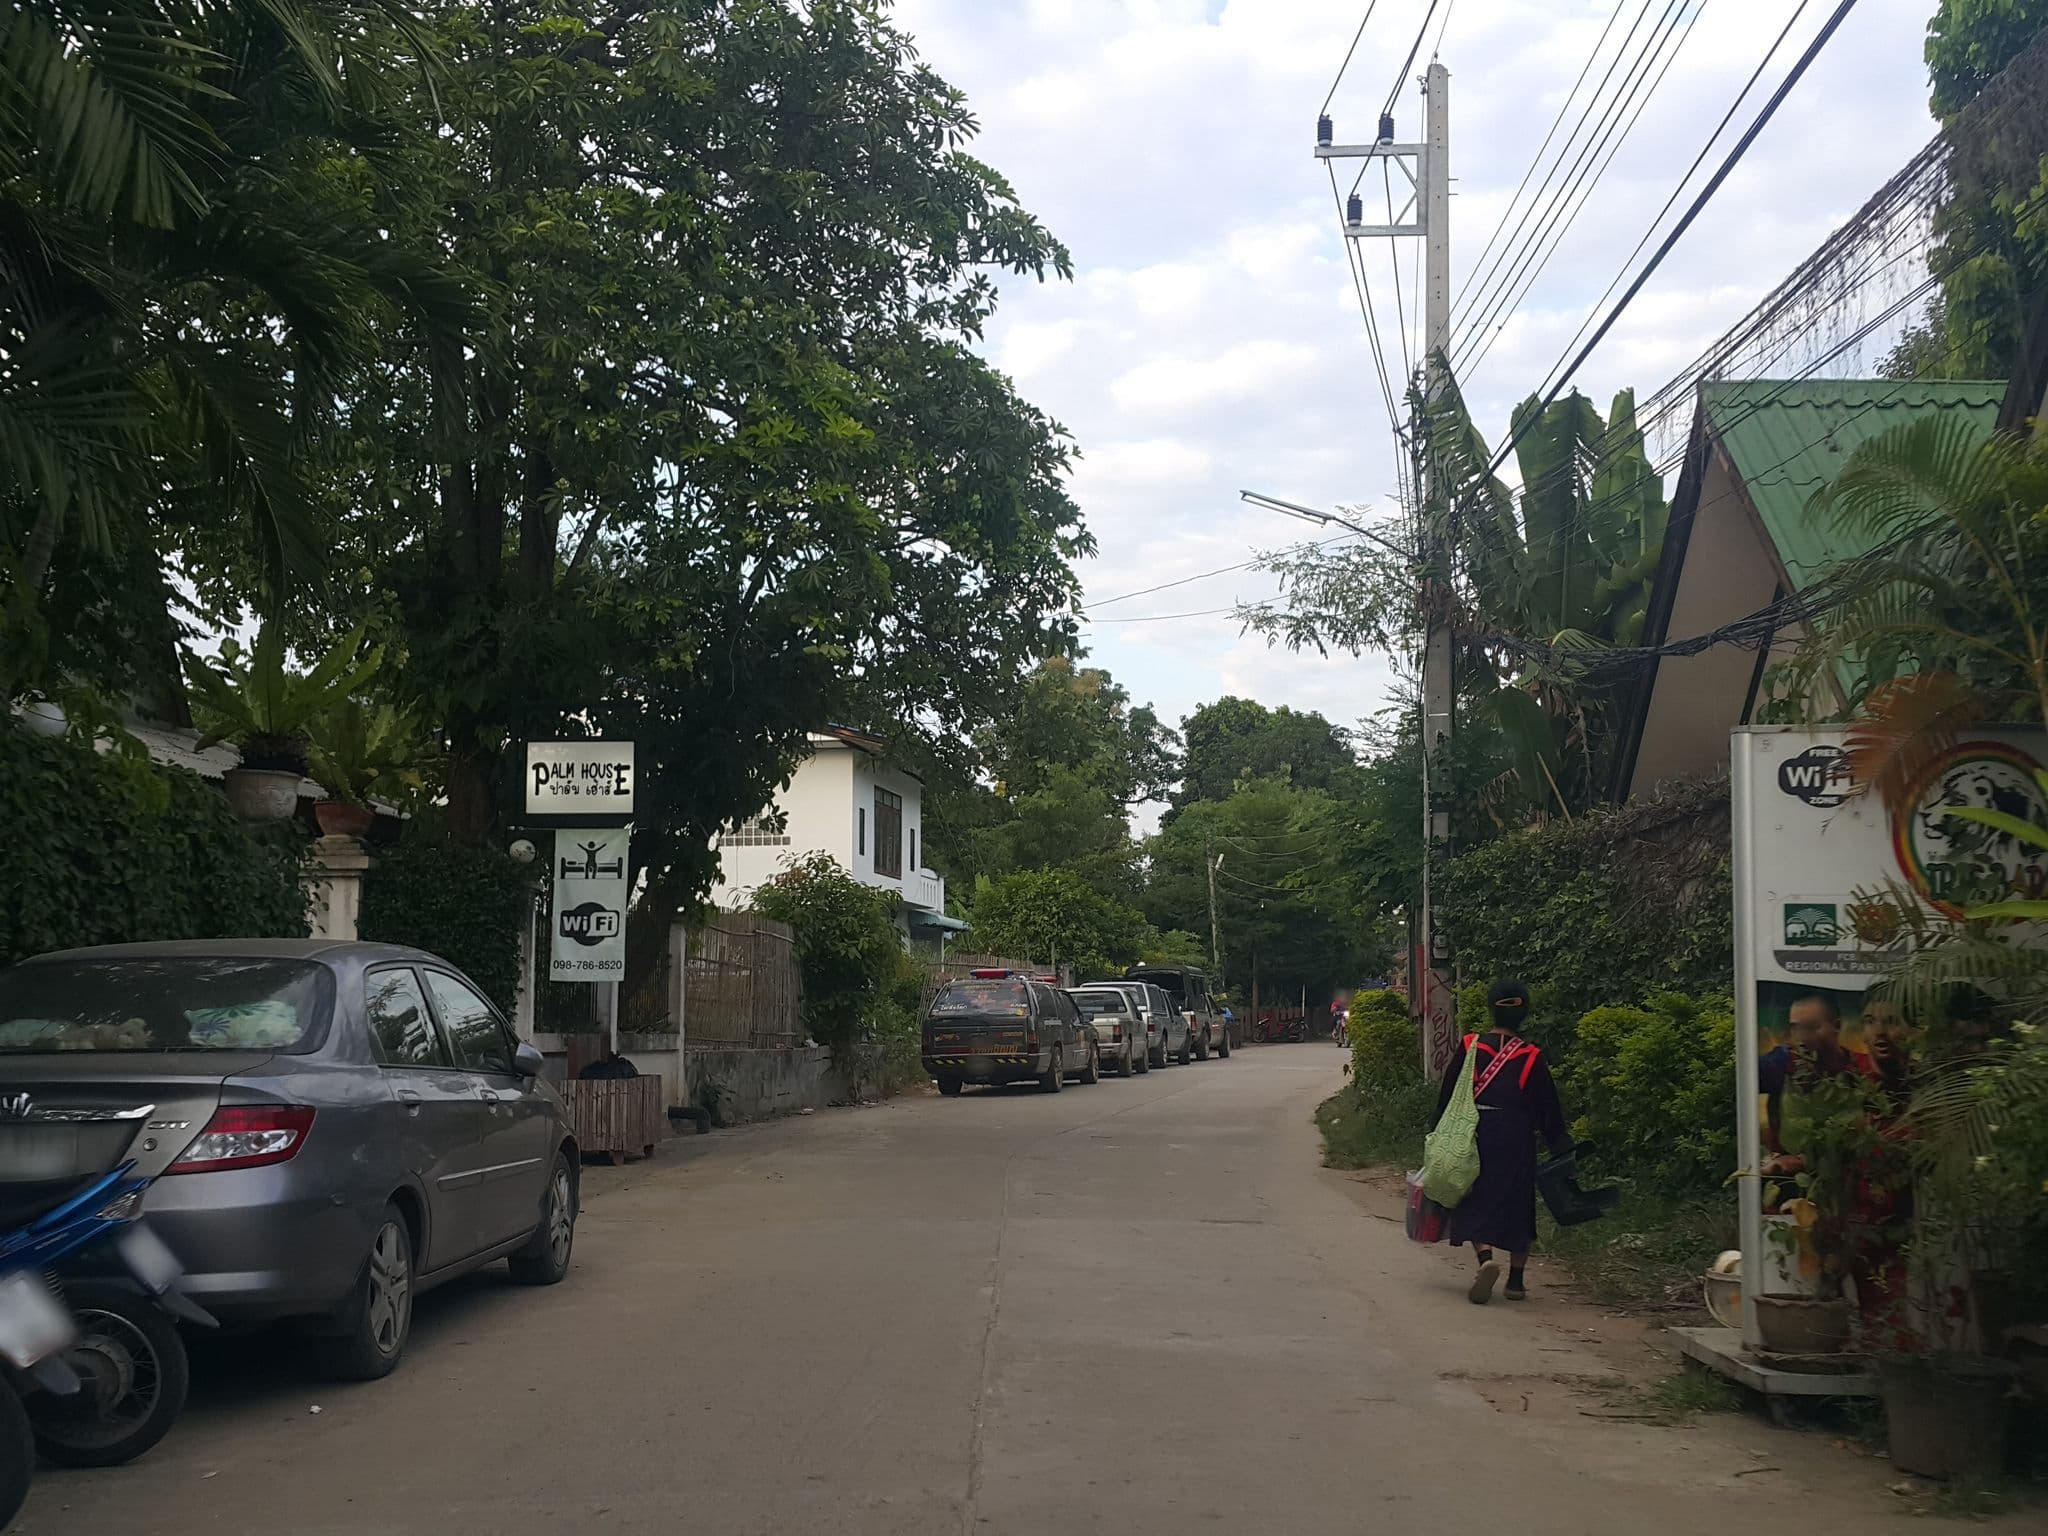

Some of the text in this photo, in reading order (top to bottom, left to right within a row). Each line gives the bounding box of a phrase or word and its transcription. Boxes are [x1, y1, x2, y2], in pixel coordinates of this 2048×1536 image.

[1808, 749, 1840, 757] FREE
[532, 762, 631, 796] PALM HOUSE
[1808, 796, 1840, 805] ZONE
[1785, 961, 1846, 972] REGIONAL
